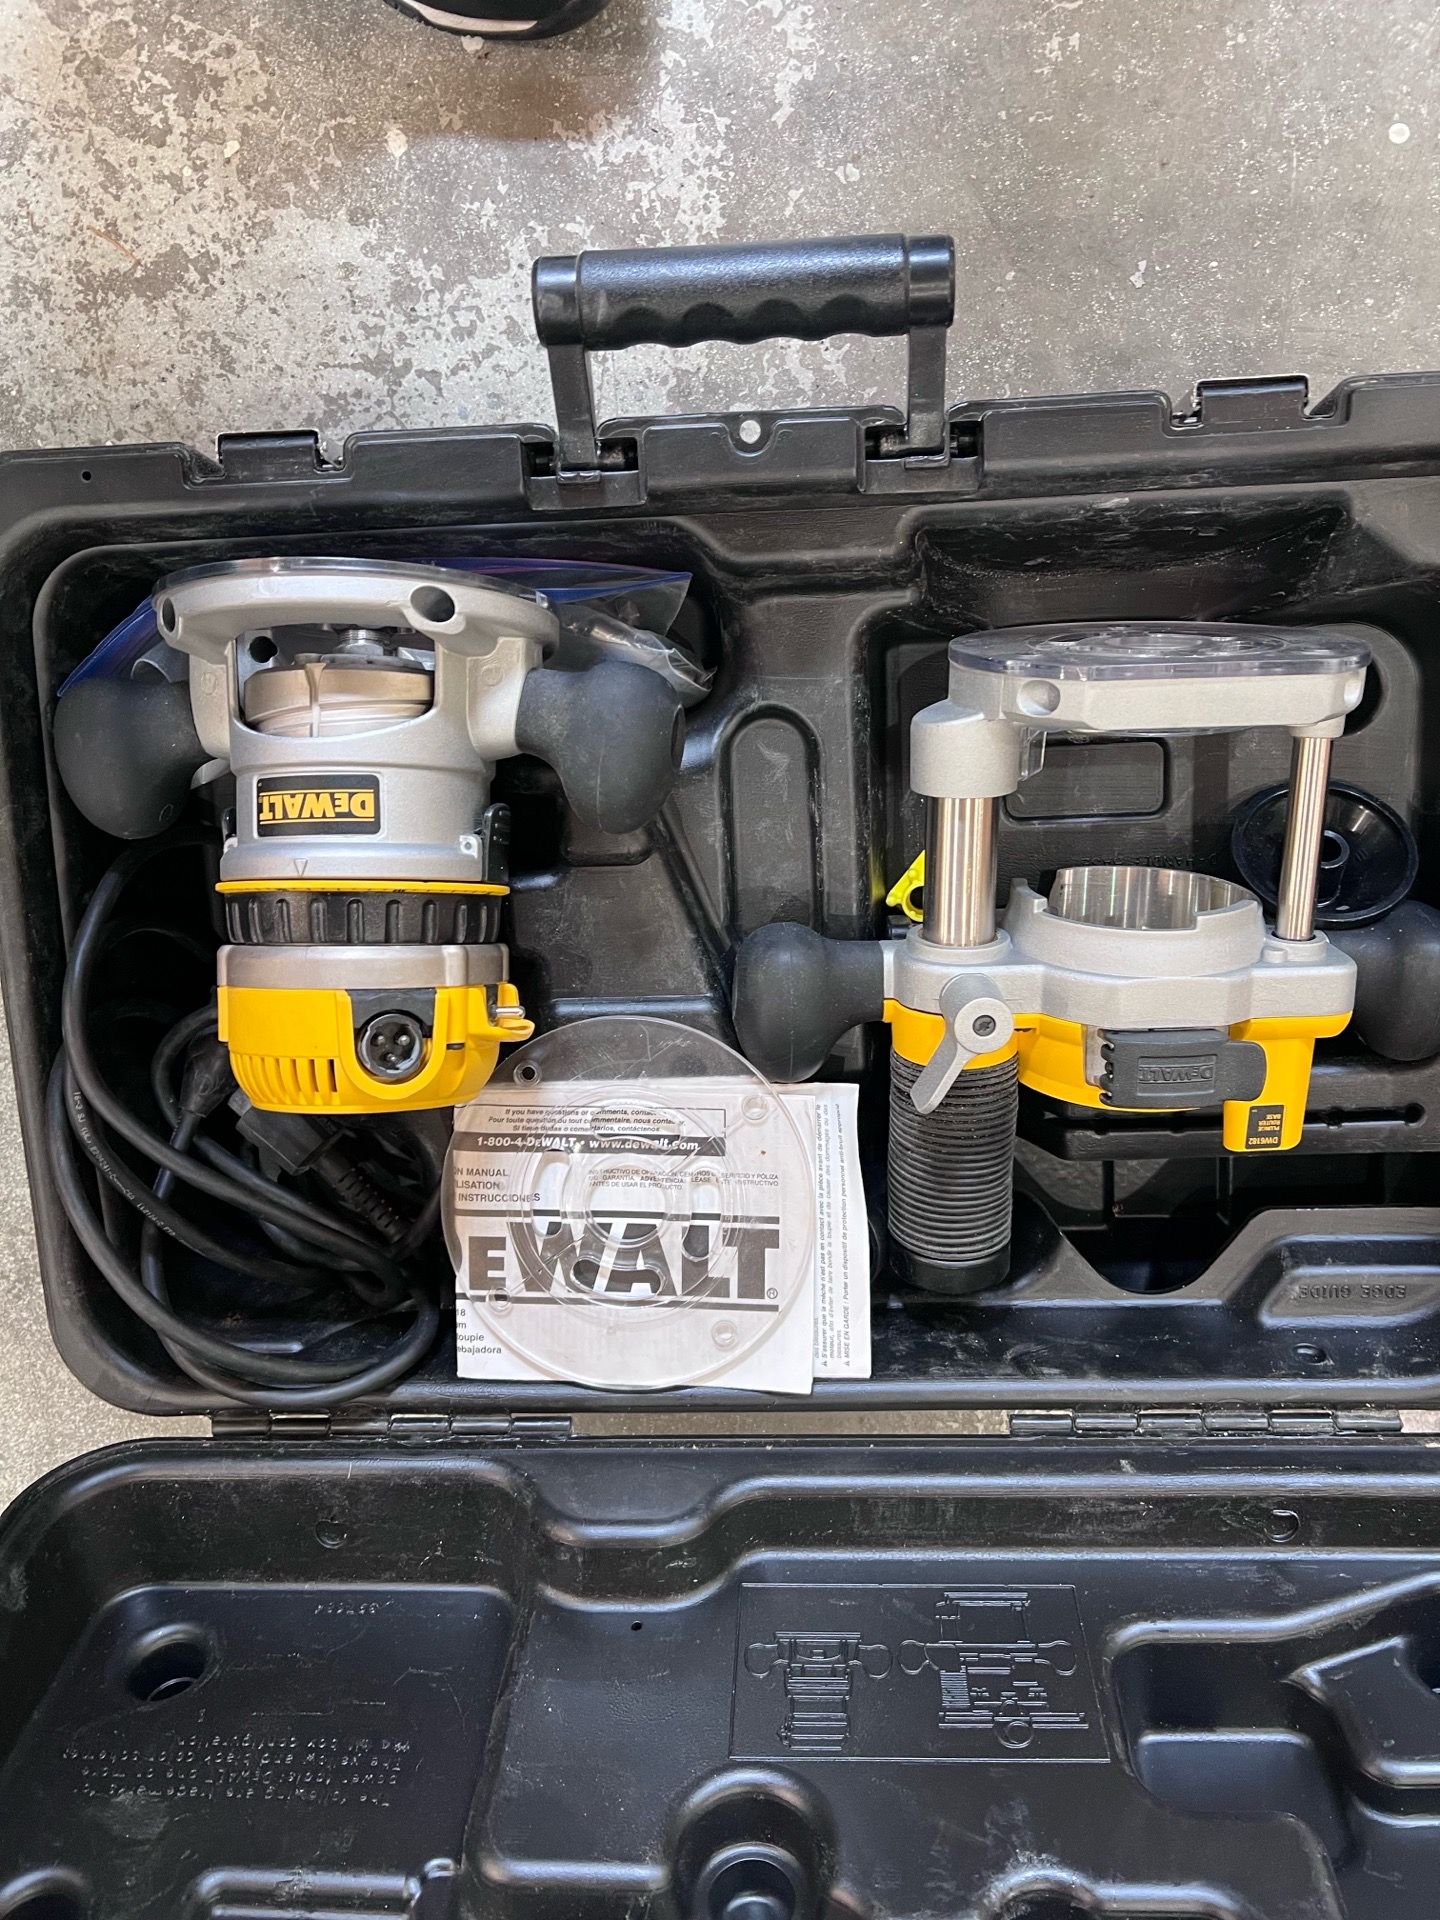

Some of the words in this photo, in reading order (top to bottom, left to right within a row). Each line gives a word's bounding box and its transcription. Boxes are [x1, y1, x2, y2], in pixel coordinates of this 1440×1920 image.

[260, 793, 374, 820] DEWALT
[466, 1167, 508, 1177] MANUAL
[456, 1221, 779, 1300] EWALT
[1299, 1284, 1351, 1299] GUIDE
